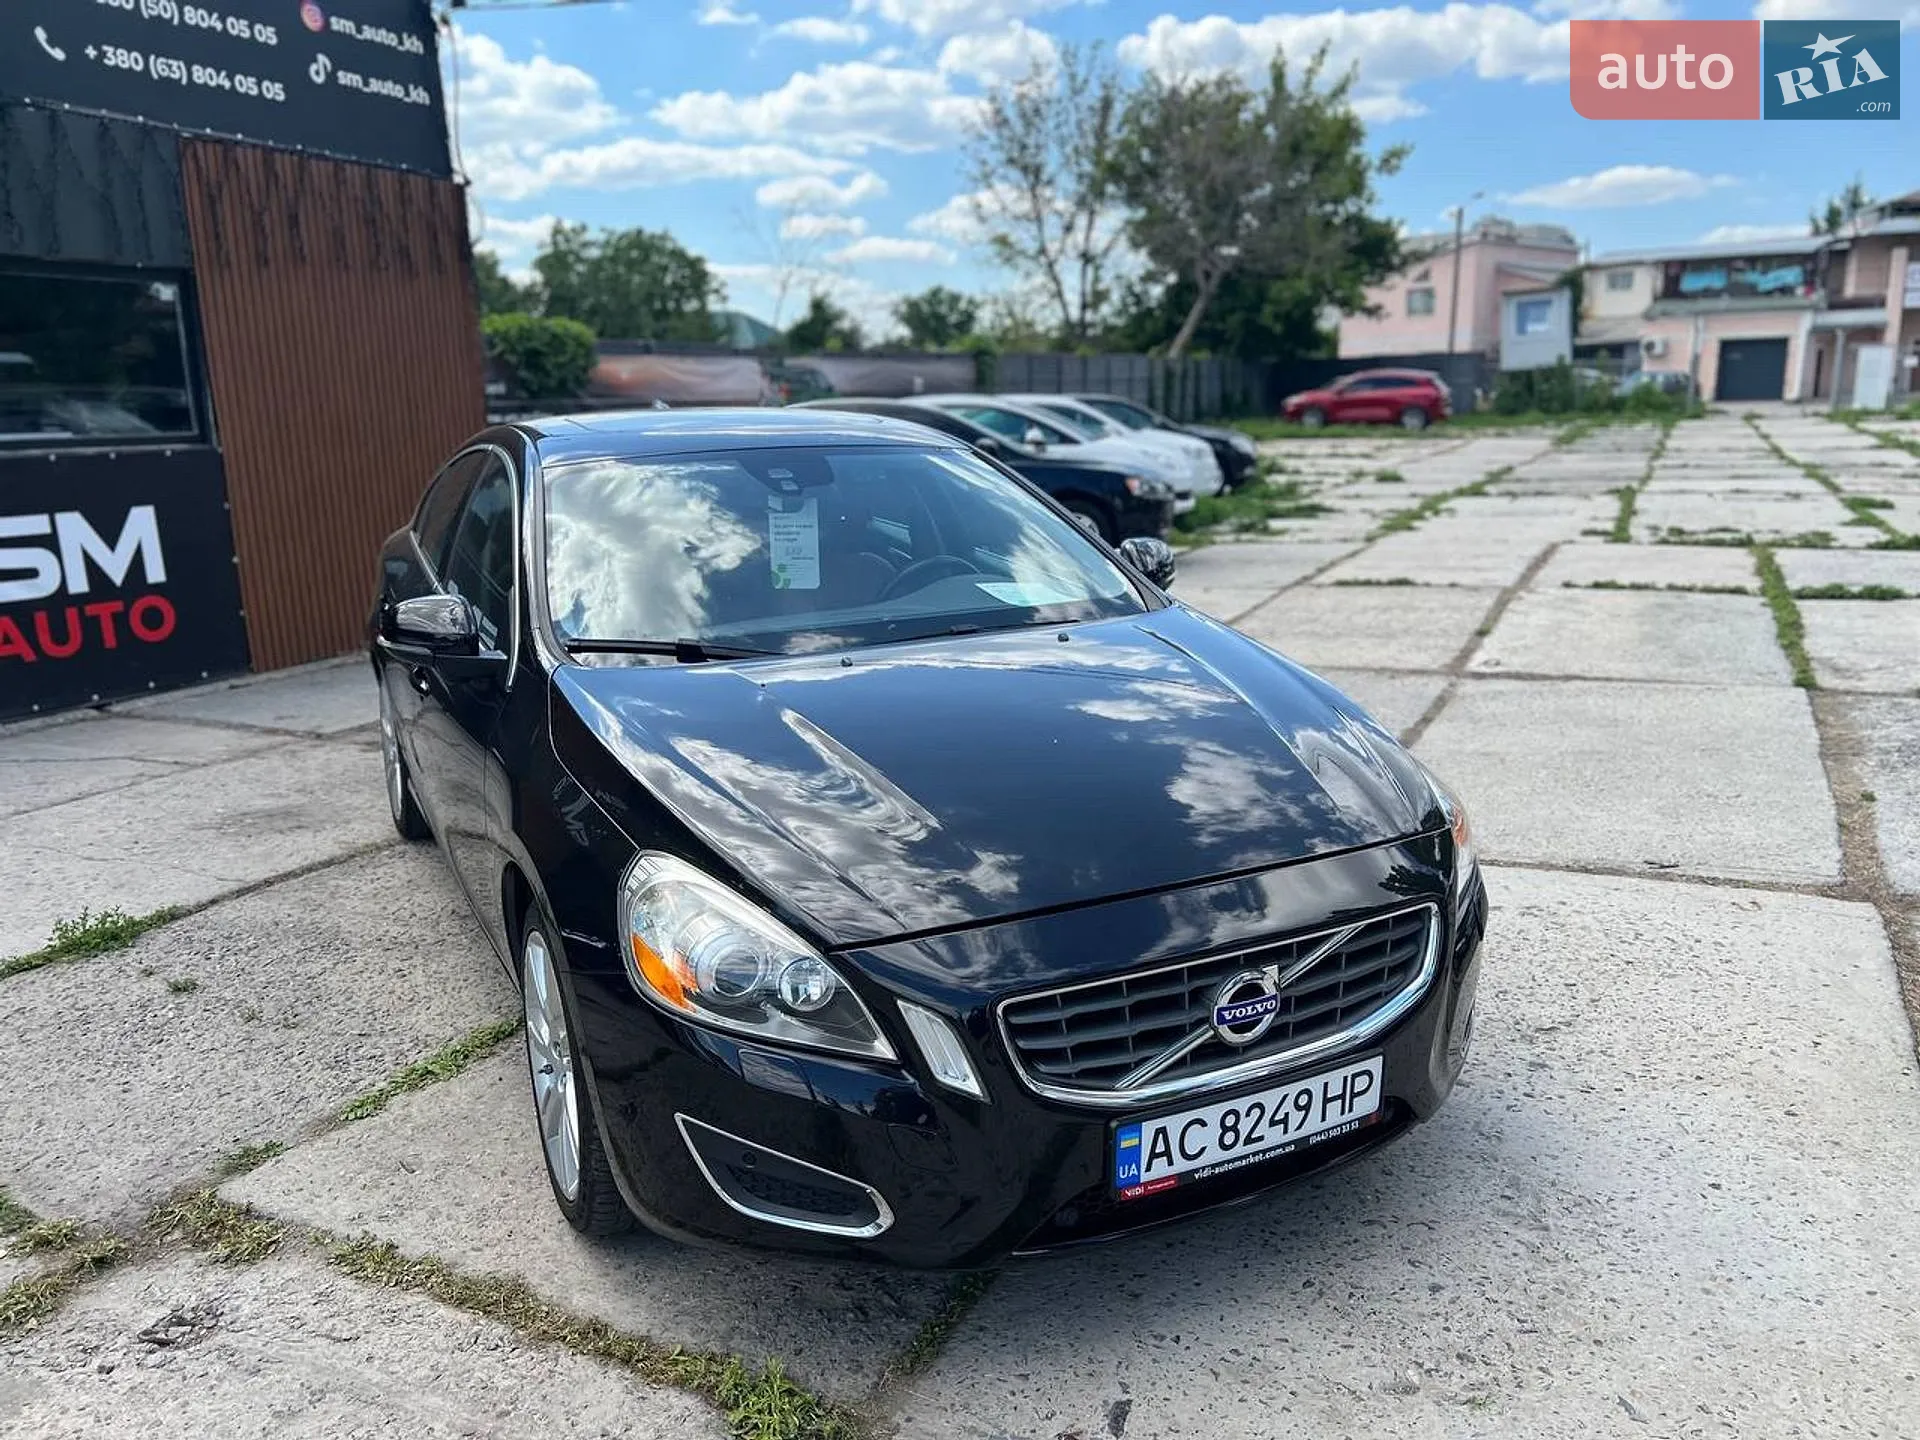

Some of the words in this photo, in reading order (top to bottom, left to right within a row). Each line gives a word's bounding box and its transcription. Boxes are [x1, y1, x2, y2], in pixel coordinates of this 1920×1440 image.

[183, 5, 224, 32] 804
[225, 16, 251, 39] 05
[253, 23, 278, 45] 05
[329, 15, 424, 55] sm_auto_kh
[101, 45, 144, 72] 380
[149, 54, 188, 86] (63)
[191, 64, 231, 90] 804
[234, 74, 259, 97] 05
[261, 80, 286, 102] 05
[337, 70, 430, 106] sm_auto_kh
[0, 504, 167, 603] SM
[0, 594, 177, 663] AUTO
[1220, 1000, 1276, 1019] VOLVO
[1145, 1118, 1208, 1173] AC
[1218, 1087, 1315, 1152] 8249
[1320, 1069, 1375, 1123] HP
[1119, 1163, 1139, 1179] UA
[1193, 1144, 1296, 1181] vidi-automarket.com.ua
